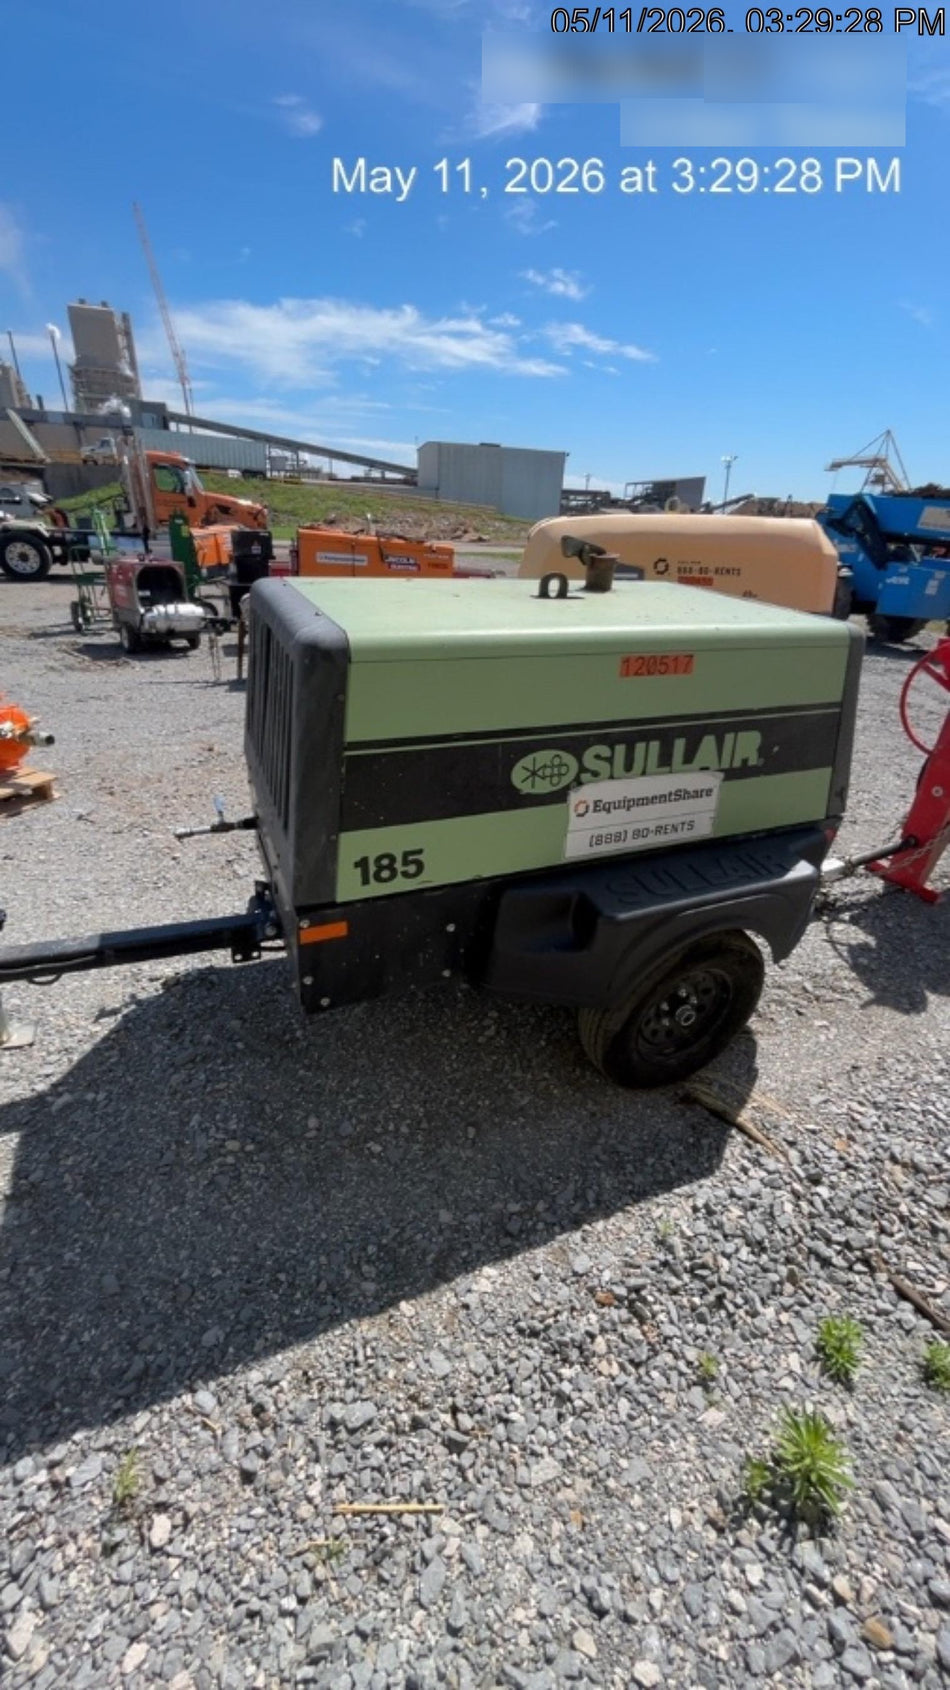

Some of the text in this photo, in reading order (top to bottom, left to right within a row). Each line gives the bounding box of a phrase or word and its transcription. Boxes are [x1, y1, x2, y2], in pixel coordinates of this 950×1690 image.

[621, 655, 694, 677] 120517
[580, 731, 762, 782] SULLAIR
[592, 787, 714, 815] EquipmentShare
[589, 820, 695, 848] (888) 80-RENTS
[354, 848, 425, 886] 185
